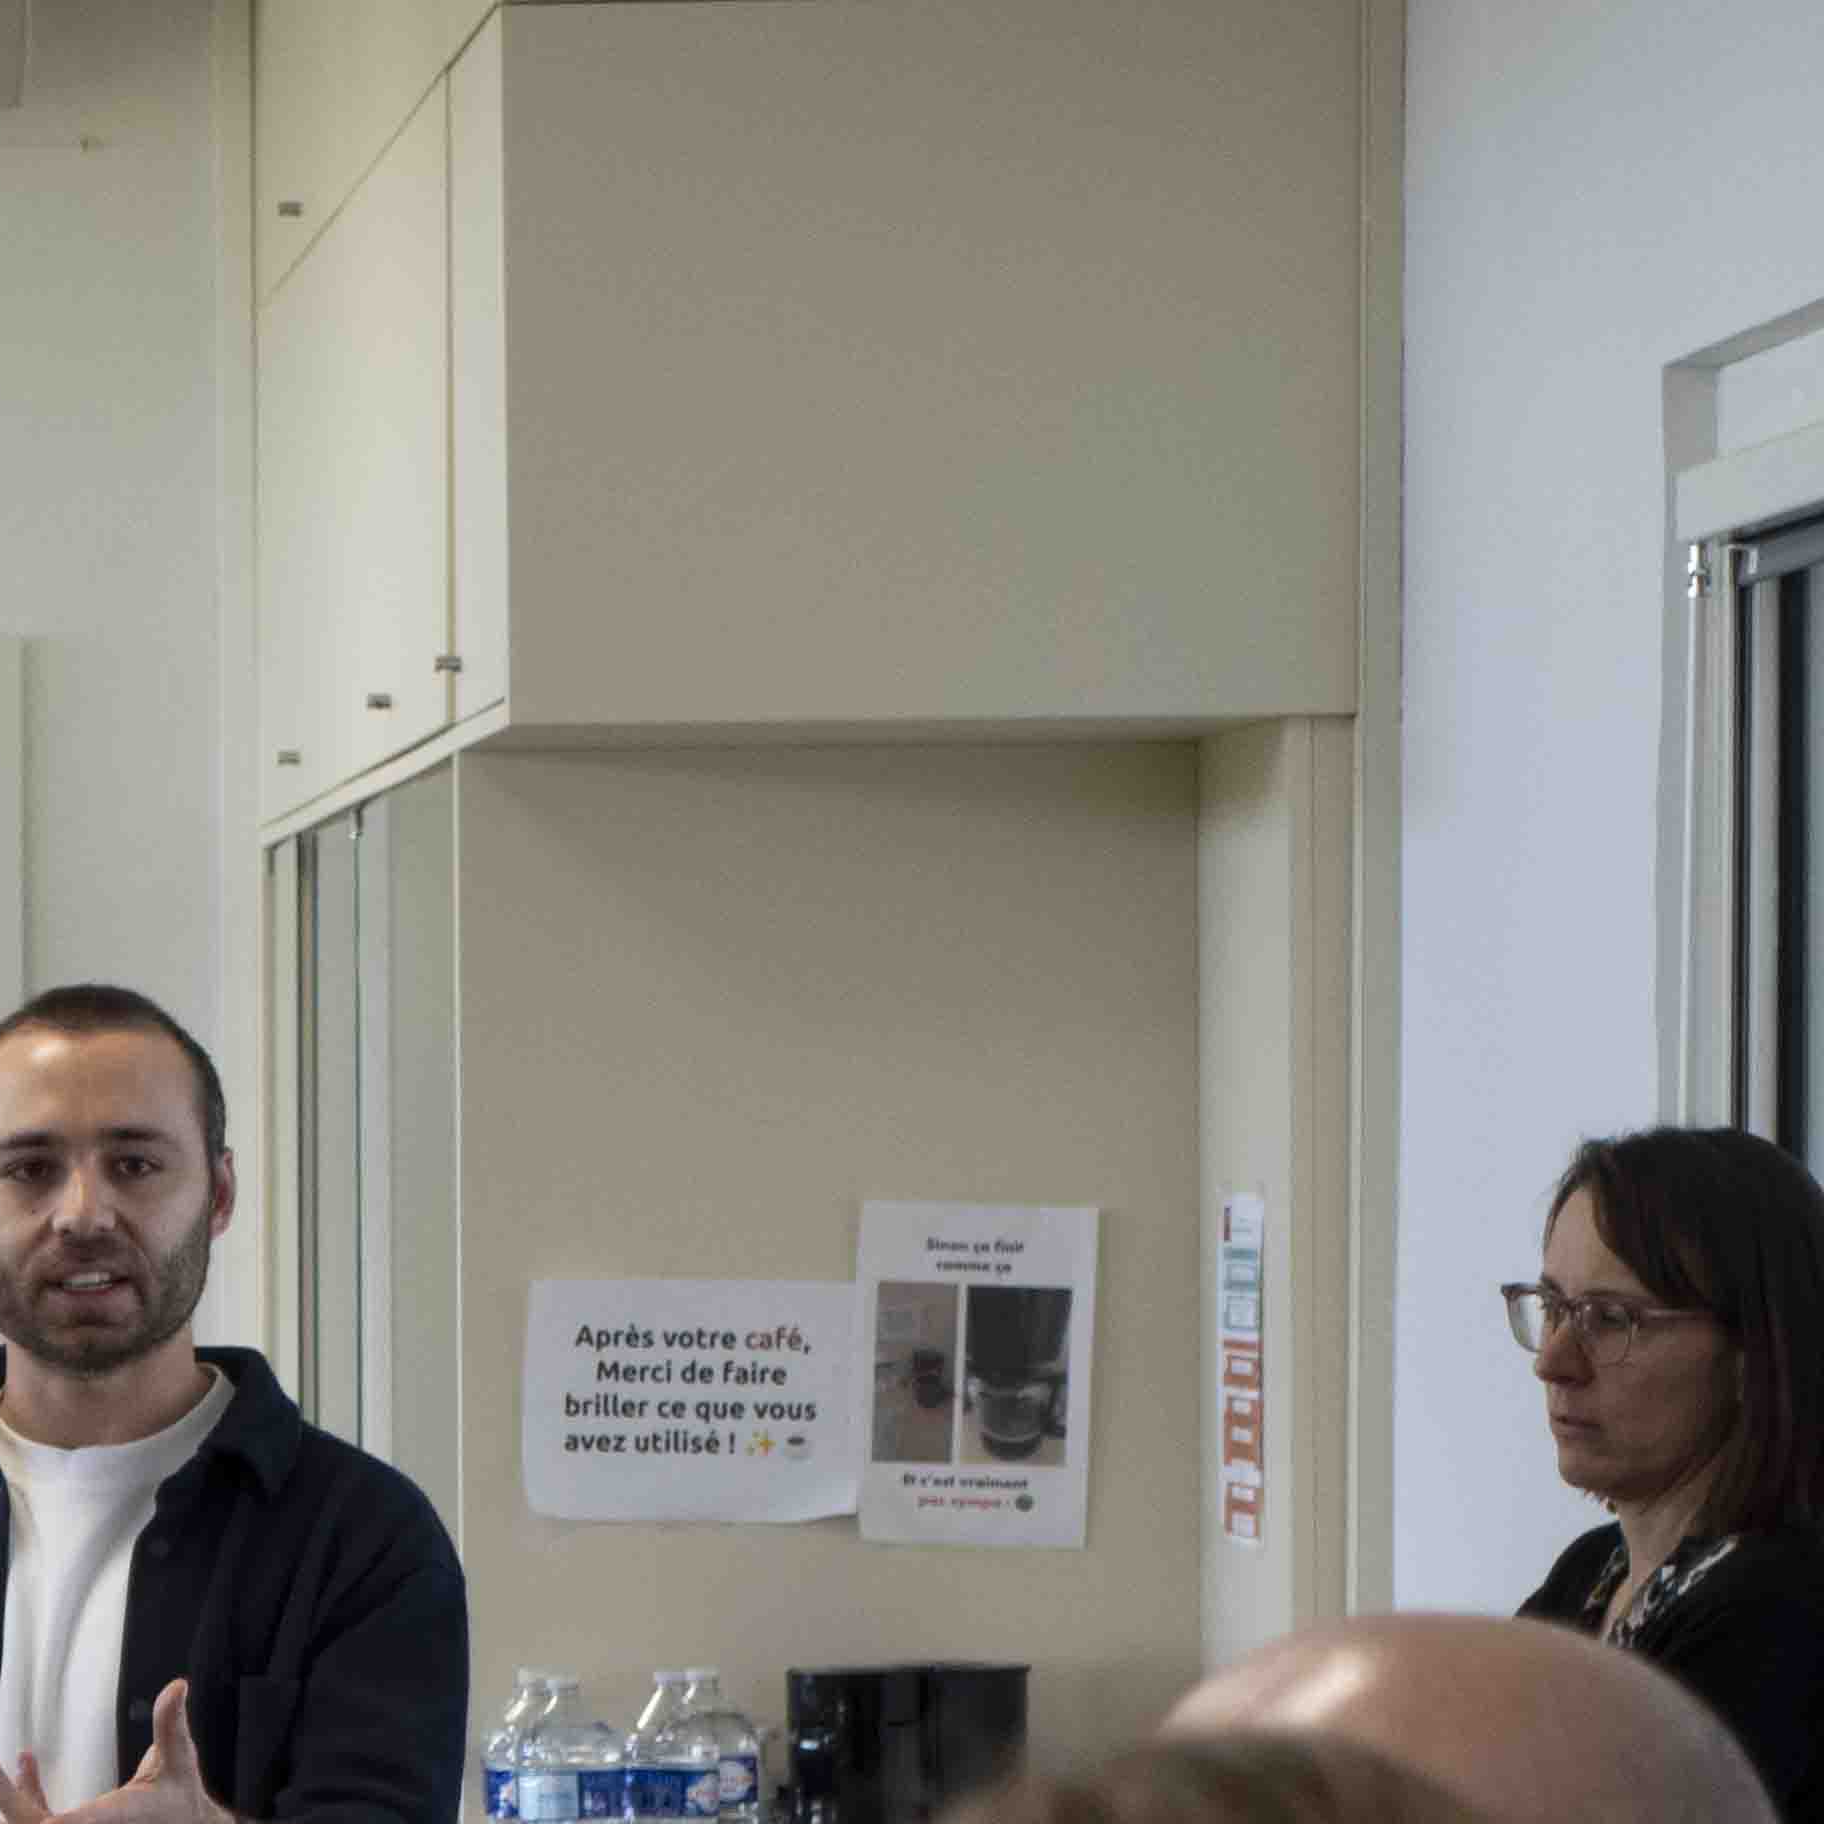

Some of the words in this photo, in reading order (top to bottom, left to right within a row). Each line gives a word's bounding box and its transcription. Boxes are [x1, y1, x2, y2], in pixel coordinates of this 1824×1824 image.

[574, 1323, 654, 1351] Après
[662, 1328, 737, 1350] votre
[744, 1324, 812, 1354] café,
[596, 1359, 672, 1384] Merci
[680, 1359, 715, 1385] de
[723, 1360, 788, 1386] faire
[564, 1391, 649, 1419] briller
[656, 1400, 686, 1419] ce
[695, 1400, 745, 1423] que
[753, 1400, 817, 1421] vous
[563, 1433, 627, 1453] avez
[634, 1427, 721, 1455] utilisé
[728, 1432, 736, 1454] !
